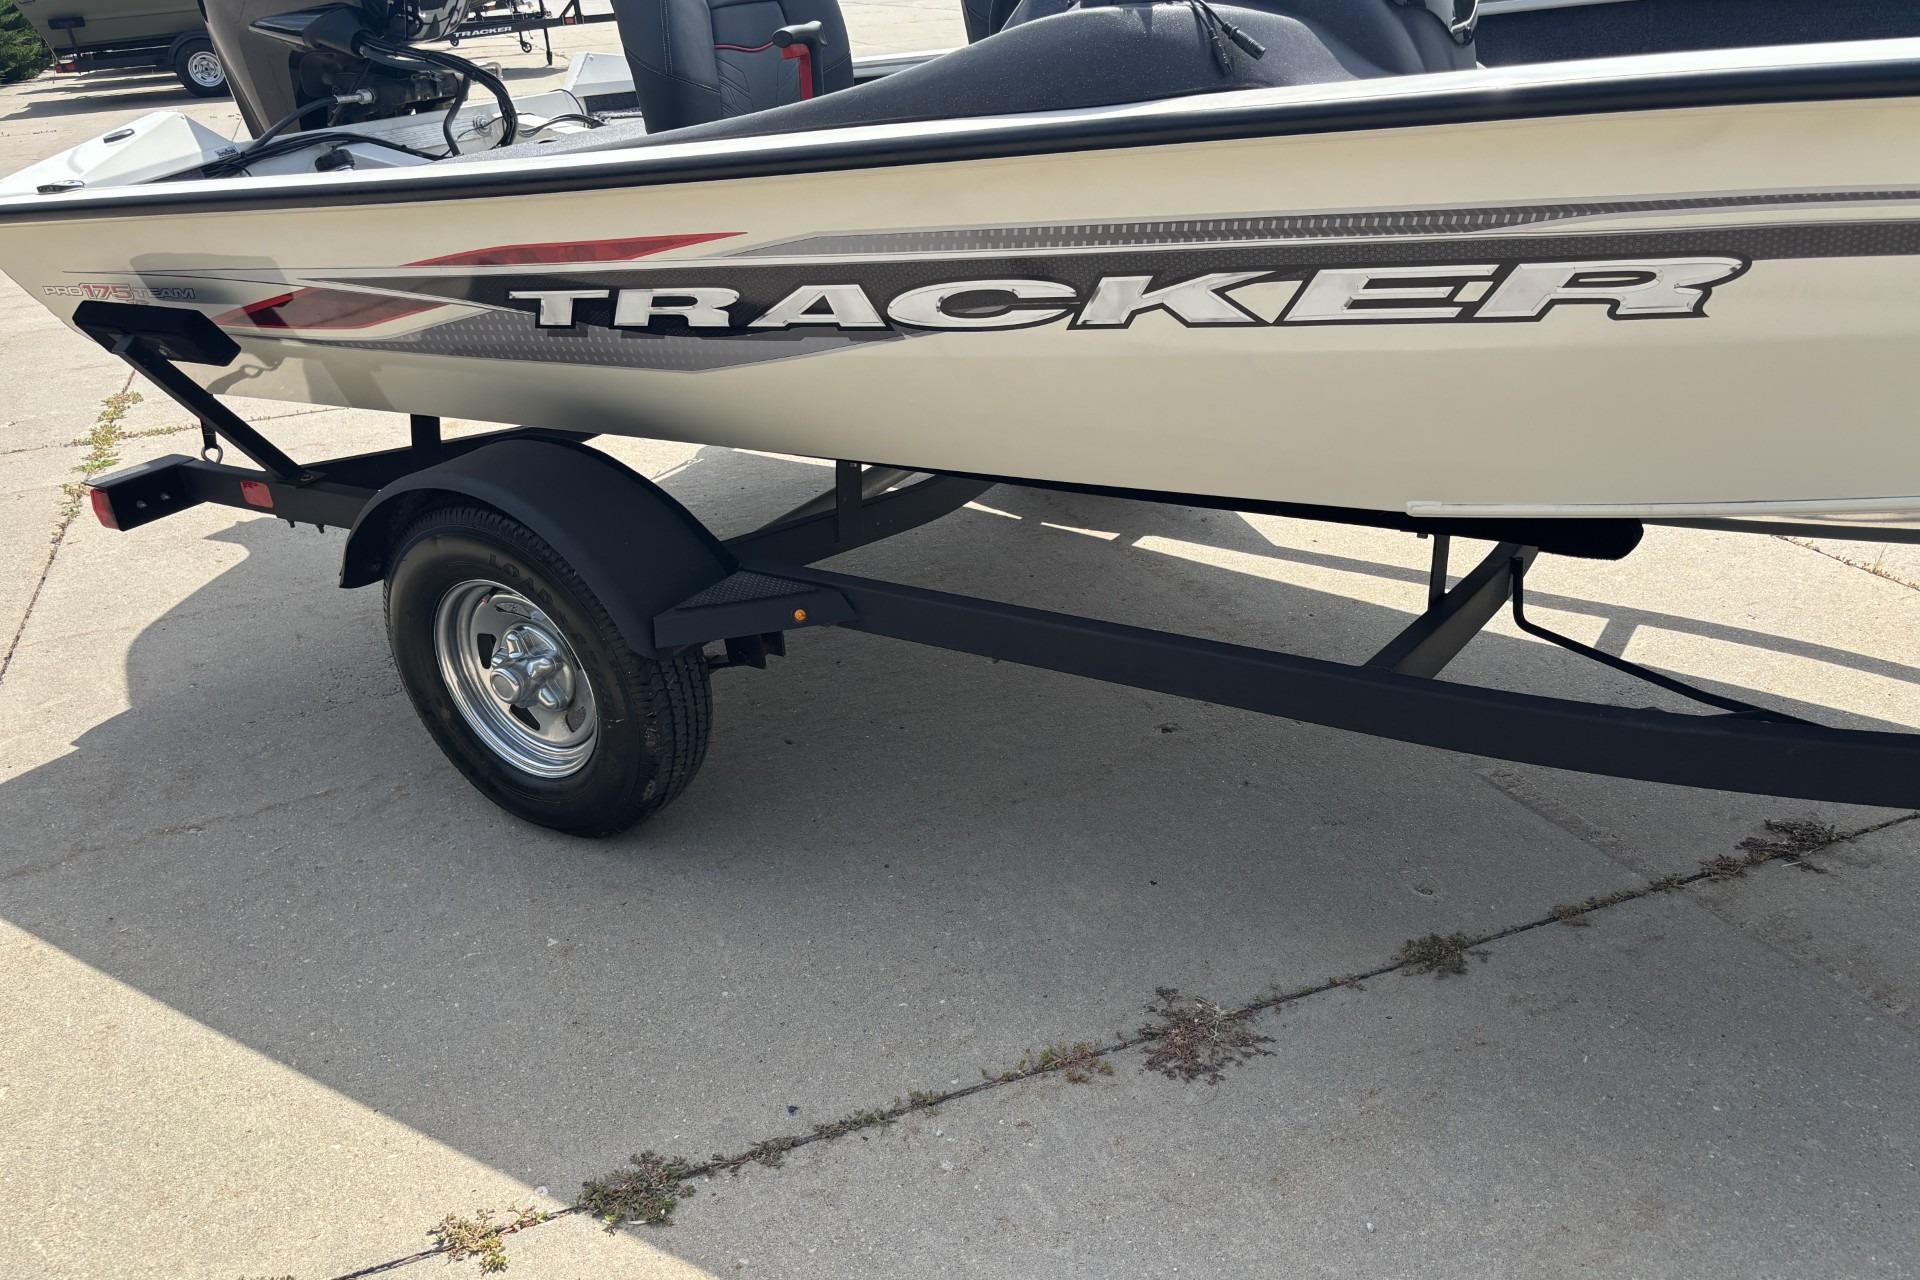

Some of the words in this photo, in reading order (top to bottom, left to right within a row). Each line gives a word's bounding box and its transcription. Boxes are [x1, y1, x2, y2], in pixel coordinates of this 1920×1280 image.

[453, 27, 512, 37] TRACKER
[43, 286, 83, 297] PRO
[80, 283, 134, 300] 175
[132, 288, 196, 300] TEAM
[508, 255, 1745, 330] TRACKER
